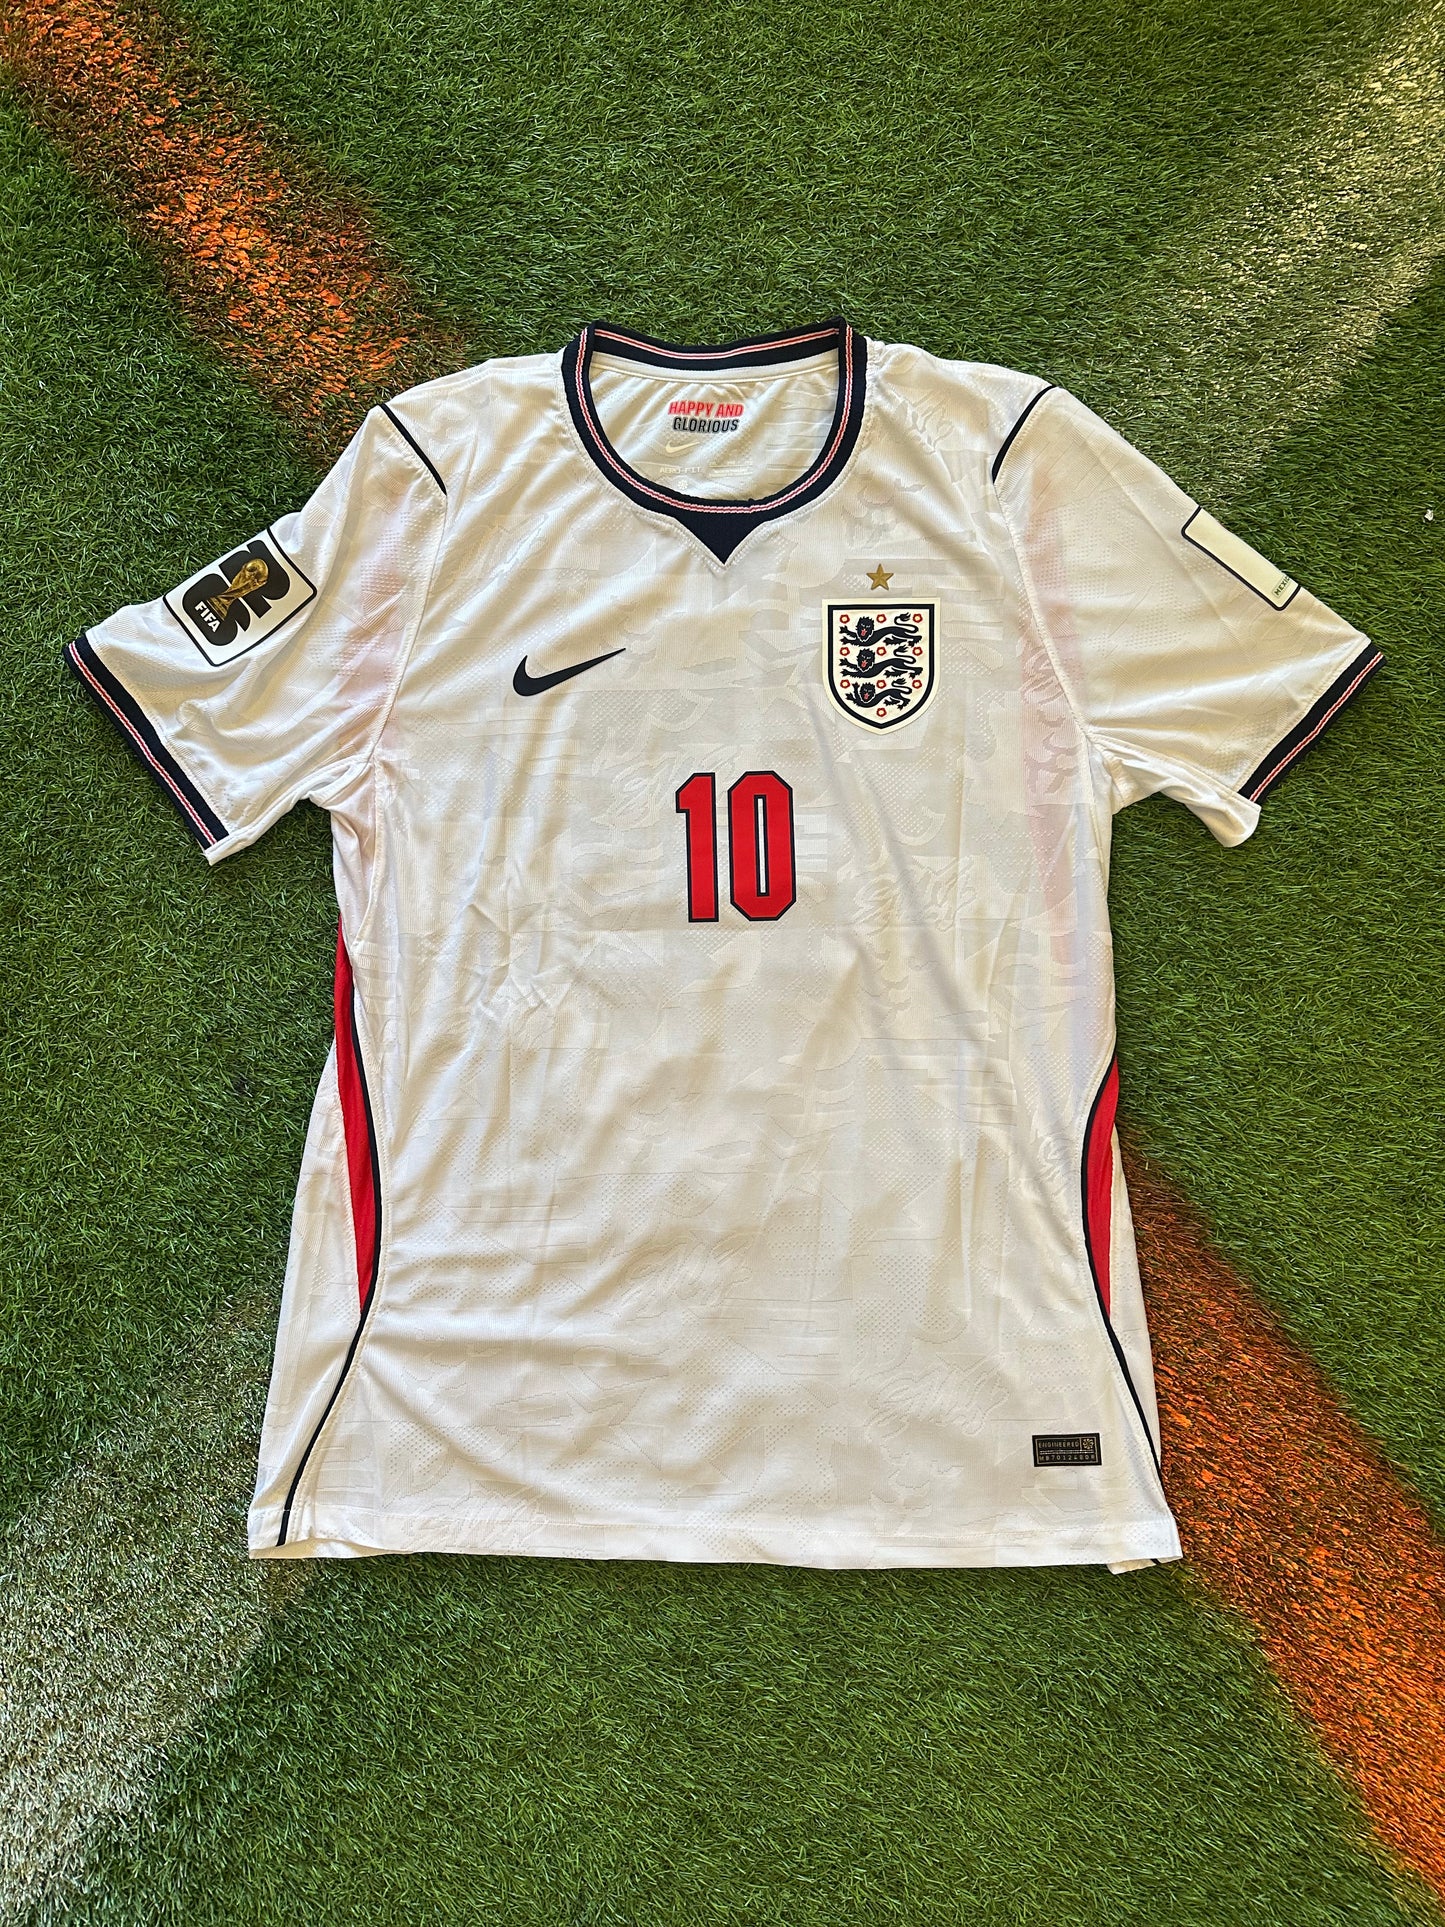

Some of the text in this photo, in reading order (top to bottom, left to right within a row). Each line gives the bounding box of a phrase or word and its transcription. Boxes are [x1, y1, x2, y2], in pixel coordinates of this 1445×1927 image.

[668, 401, 744, 418] HAPPY AND
[673, 417, 739, 433] GLORIOUS
[194, 601, 221, 633] FIFA
[675, 770, 797, 923] 10
[1038, 1441, 1080, 1449] ENGINEERED
